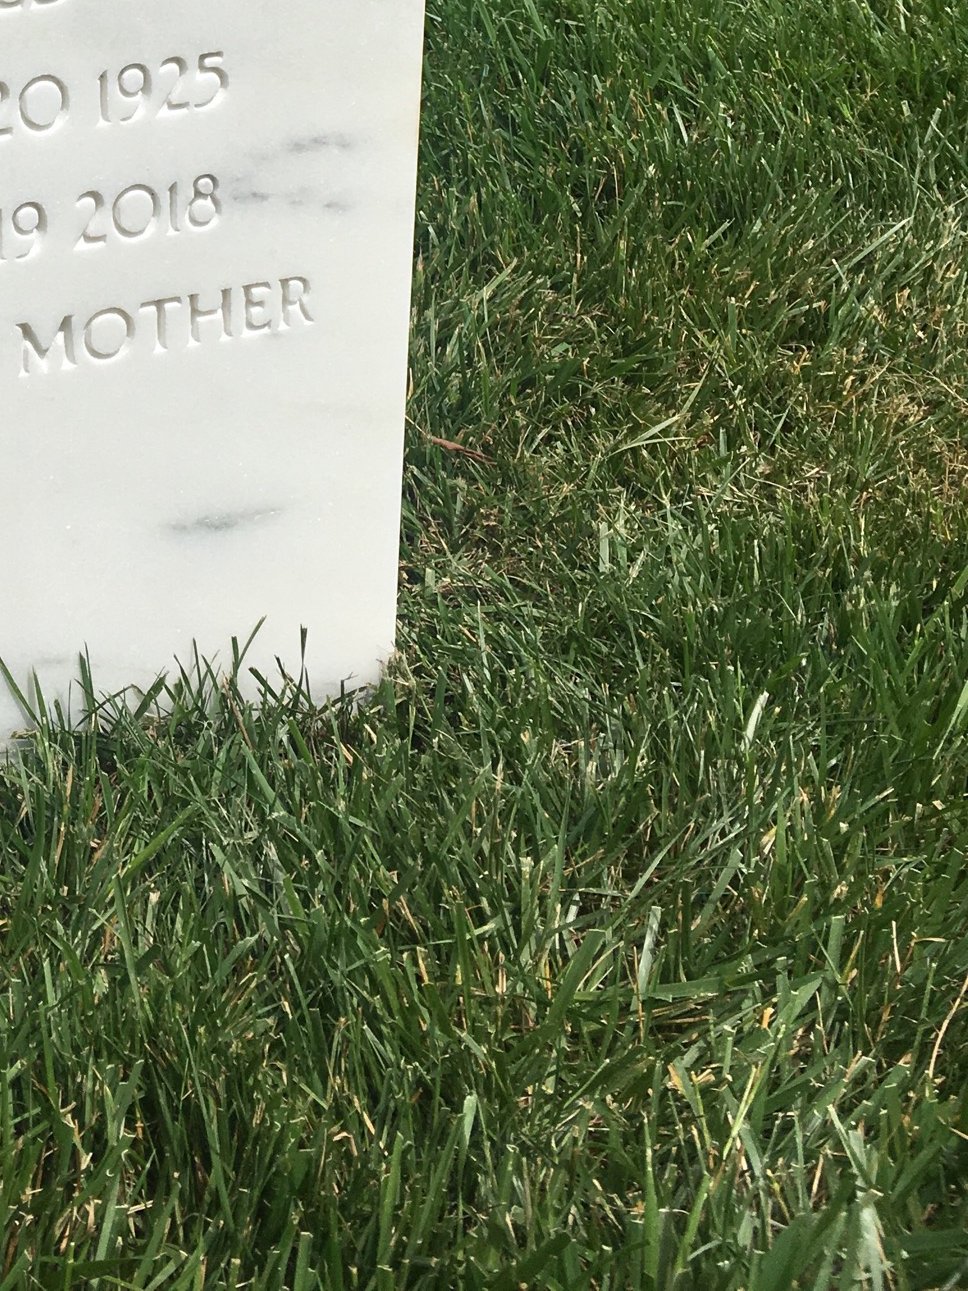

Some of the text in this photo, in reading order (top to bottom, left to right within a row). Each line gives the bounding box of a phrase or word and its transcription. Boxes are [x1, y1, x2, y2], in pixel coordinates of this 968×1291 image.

[95, 51, 231, 128] 1925
[74, 173, 224, 252] 2018
[16, 275, 316, 378] MOTHER
